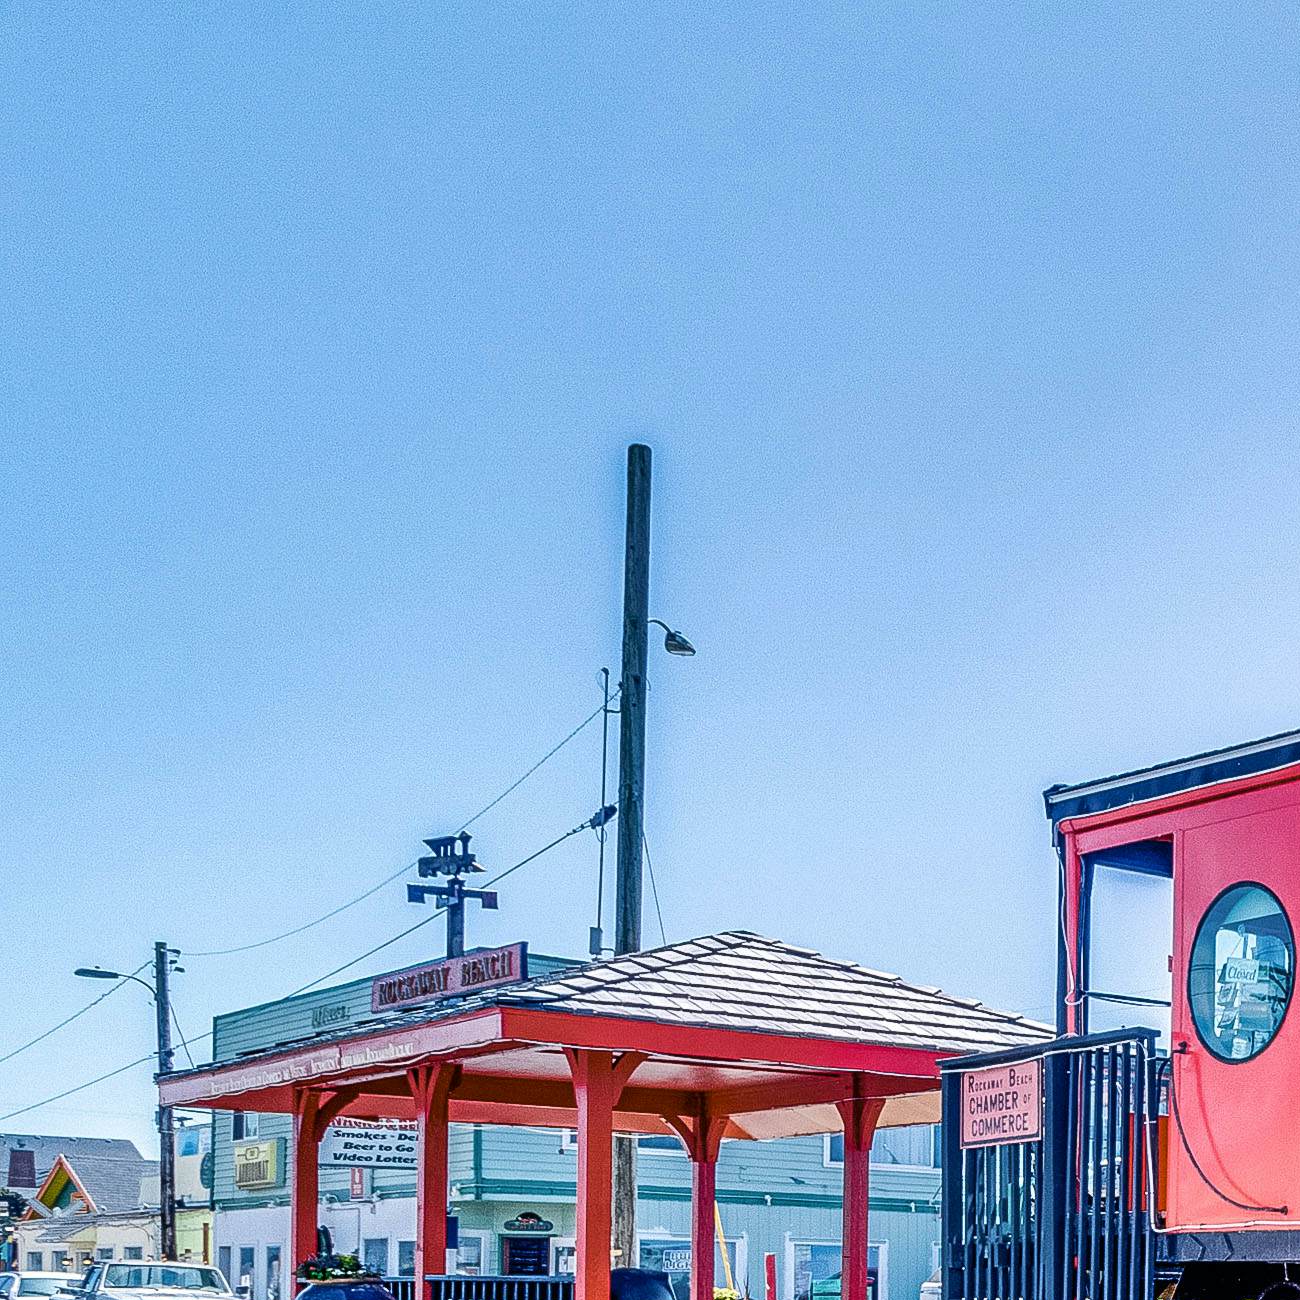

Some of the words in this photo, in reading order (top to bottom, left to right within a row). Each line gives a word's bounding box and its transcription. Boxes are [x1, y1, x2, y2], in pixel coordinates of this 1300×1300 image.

[378, 966, 451, 1005] ROCKAWAY
[461, 951, 513, 987] BEACH
[1228, 966, 1257, 981] Closed
[968, 1075, 1003, 1094] ROCKAWAY
[1009, 1068, 1033, 1087] BEACH
[969, 1091, 1019, 1116] CHAMBER
[1023, 1094, 1032, 1105] OF
[971, 1112, 1030, 1138] COMMERCE
[332, 1130, 387, 1141] Smokes
[397, 1133, 419, 1142] Del
[343, 1142, 376, 1151] Beer
[378, 1144, 393, 1152] to
[395, 1144, 415, 1153] Go
[332, 1153, 373, 1162] Video
[375, 1154, 418, 1164] Lotter
